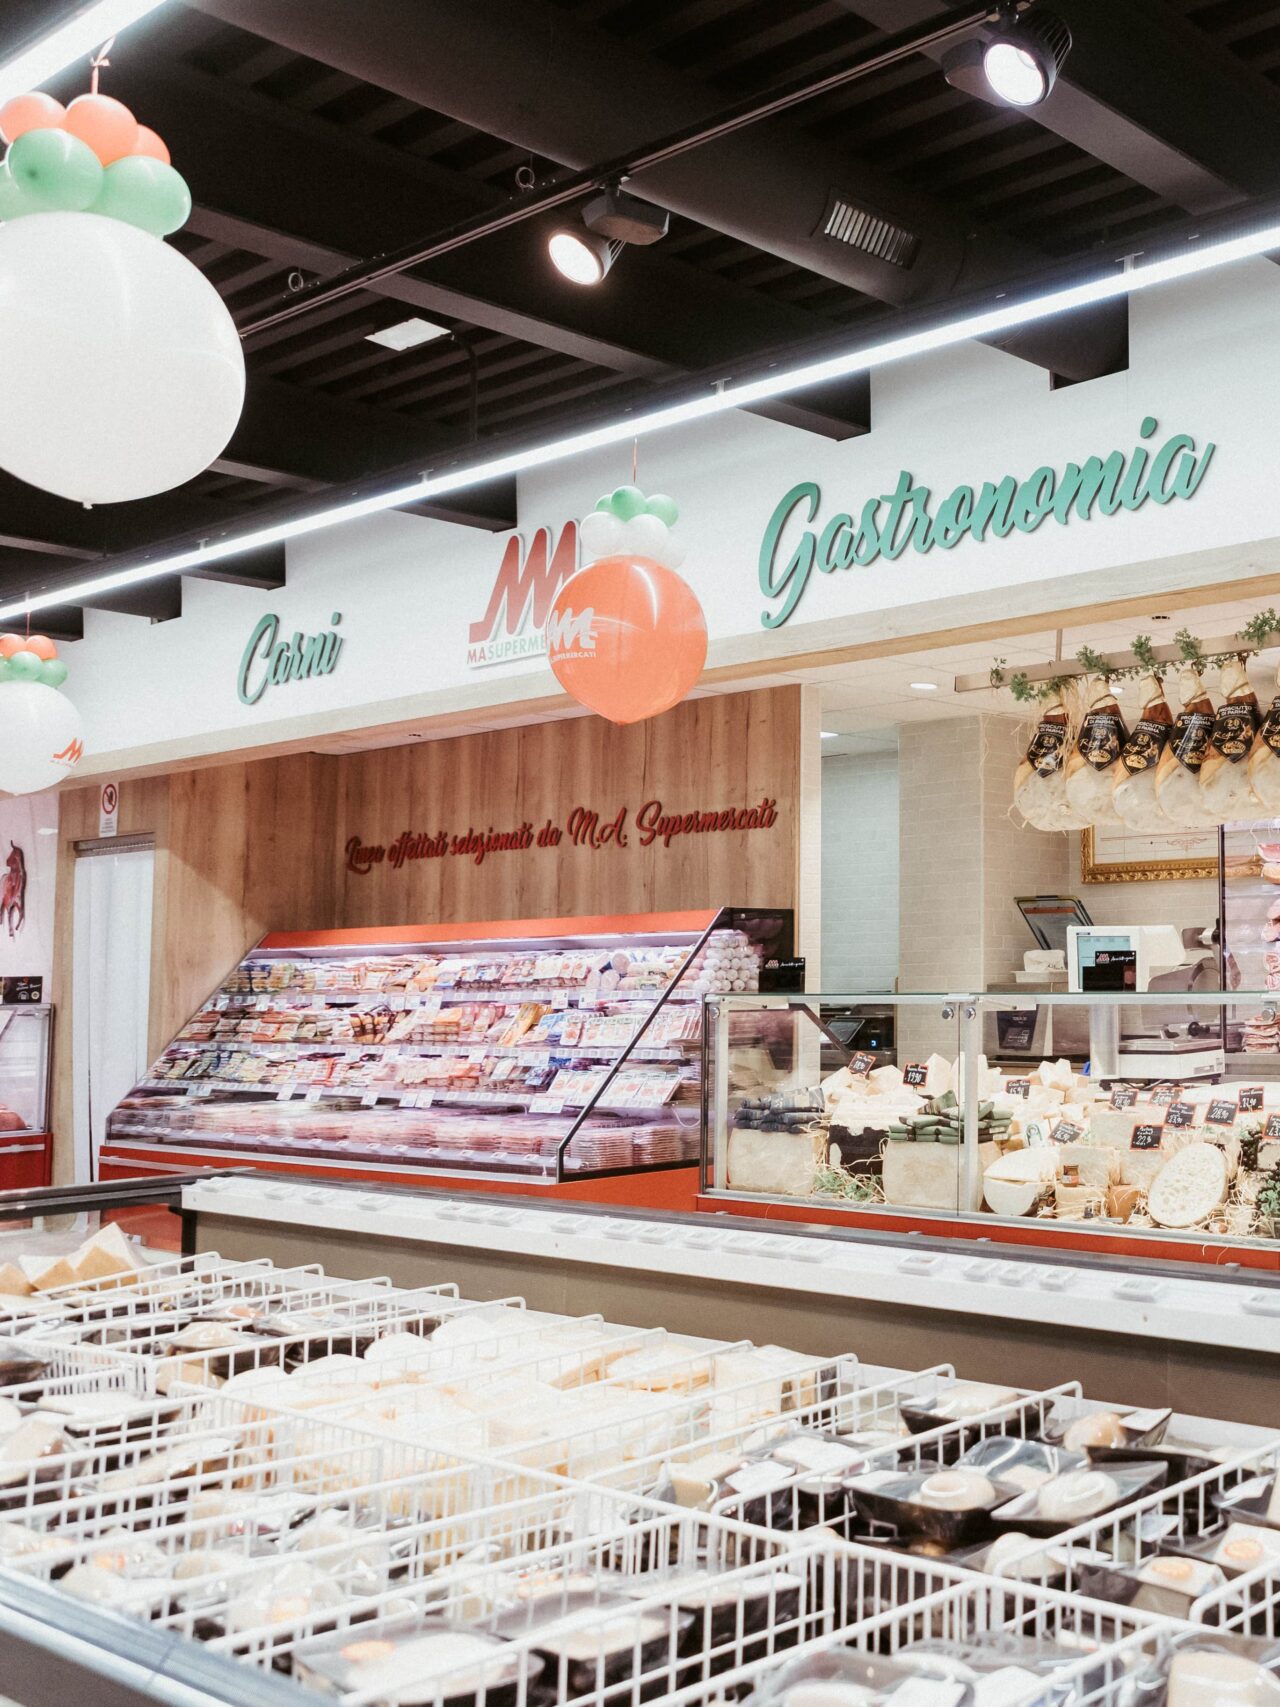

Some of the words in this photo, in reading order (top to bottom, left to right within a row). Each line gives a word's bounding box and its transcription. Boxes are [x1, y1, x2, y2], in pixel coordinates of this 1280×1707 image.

[757, 415, 1216, 630] Gastronomia
[236, 611, 344, 705] Carni
[1039, 723, 1066, 732] PROSCIUTT
[1180, 714, 1215, 722] PROSCIUTTO
[1219, 704, 1253, 713] PROSCIUTTO
[345, 835, 385, 875] Linea
[536, 819, 562, 847] da
[635, 798, 779, 848] Supermercati
